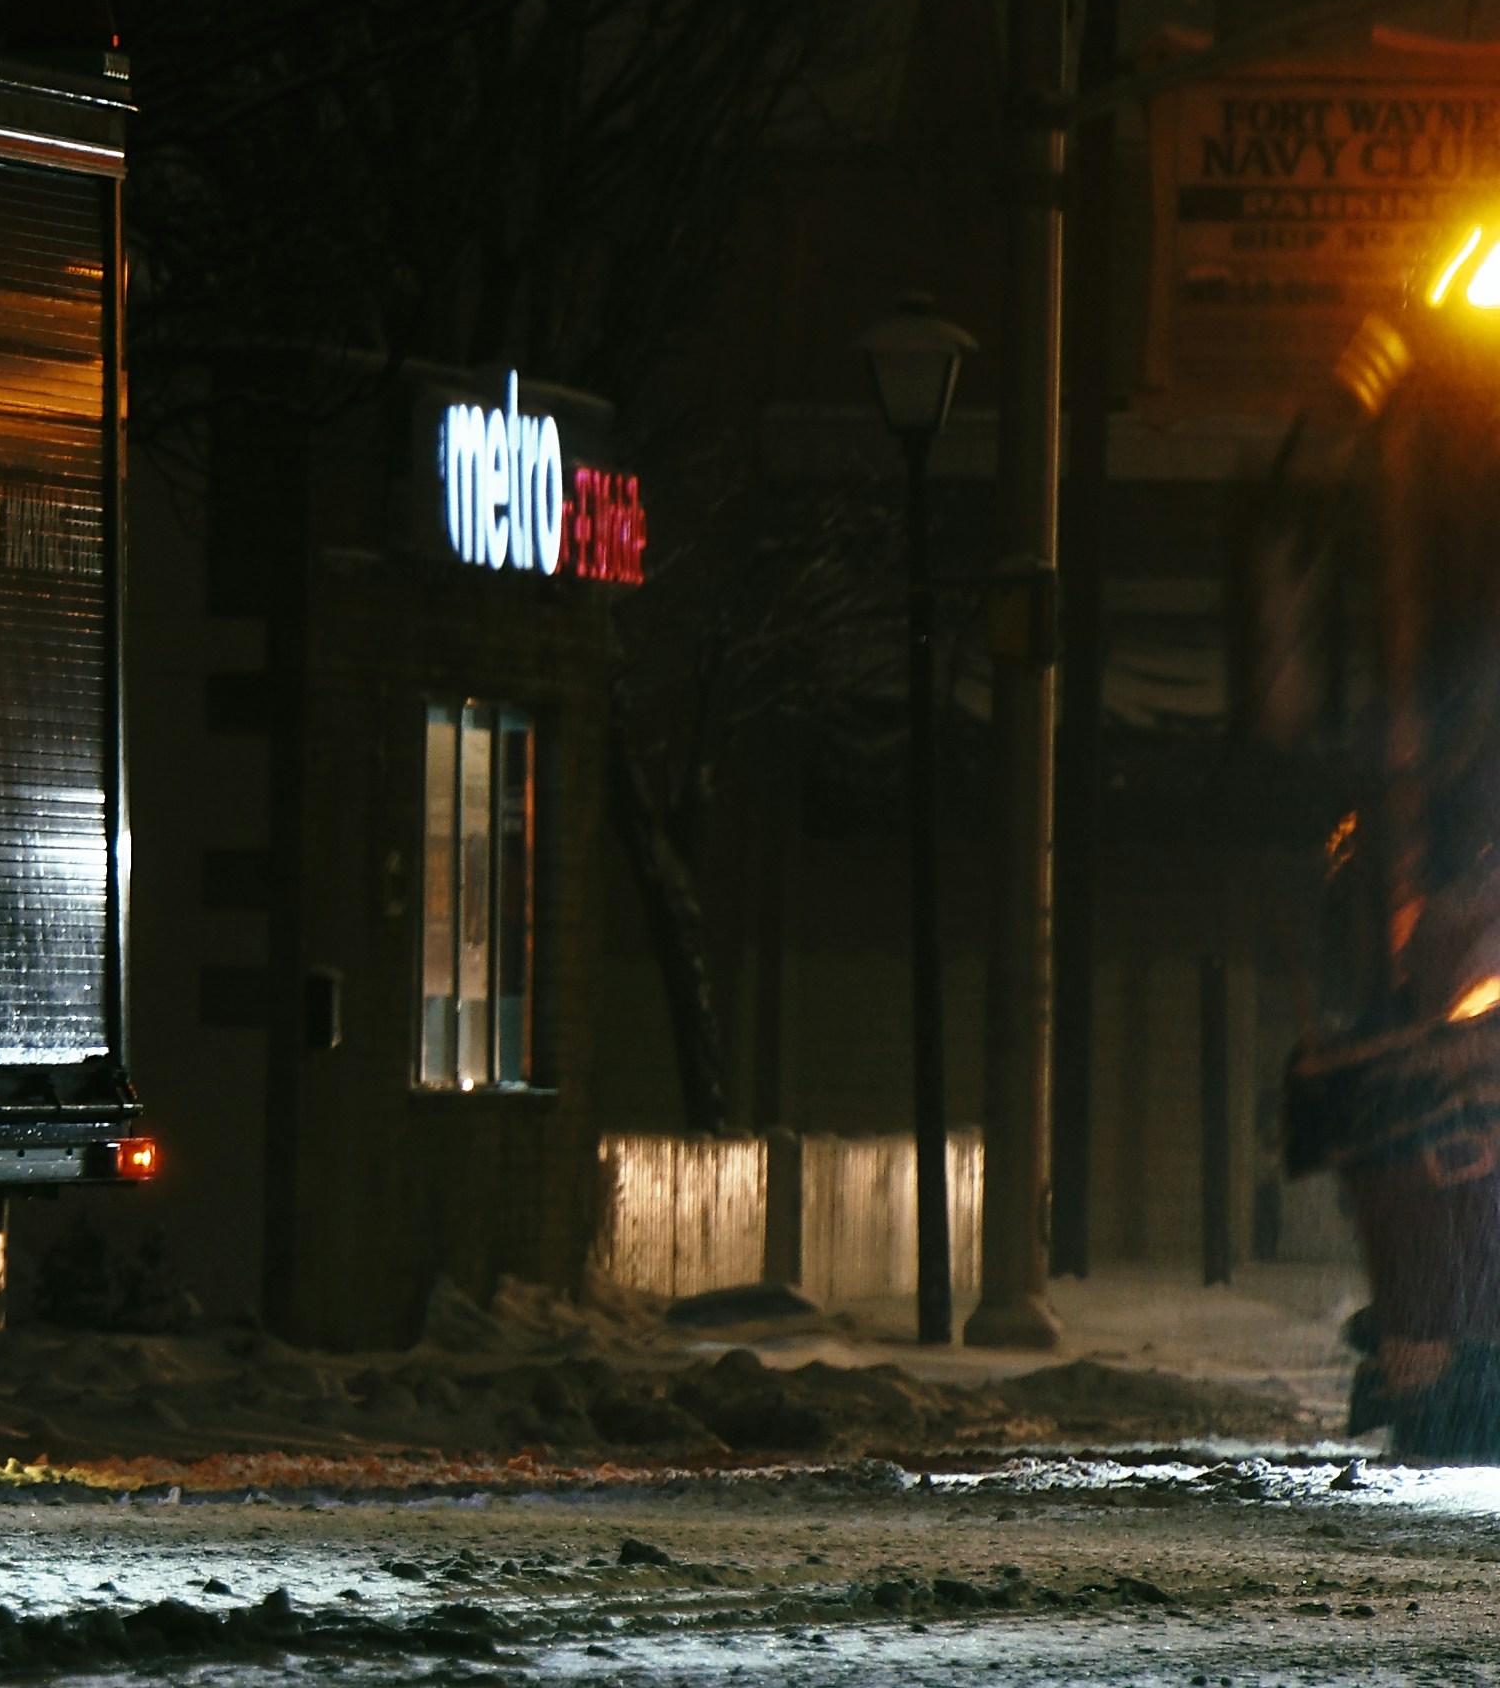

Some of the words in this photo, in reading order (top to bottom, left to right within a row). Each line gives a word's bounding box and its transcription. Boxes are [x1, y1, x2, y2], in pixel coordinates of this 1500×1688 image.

[1220, 97, 1334, 134] FORT
[1200, 135, 1348, 178] NAVY
[444, 368, 563, 576] metro
